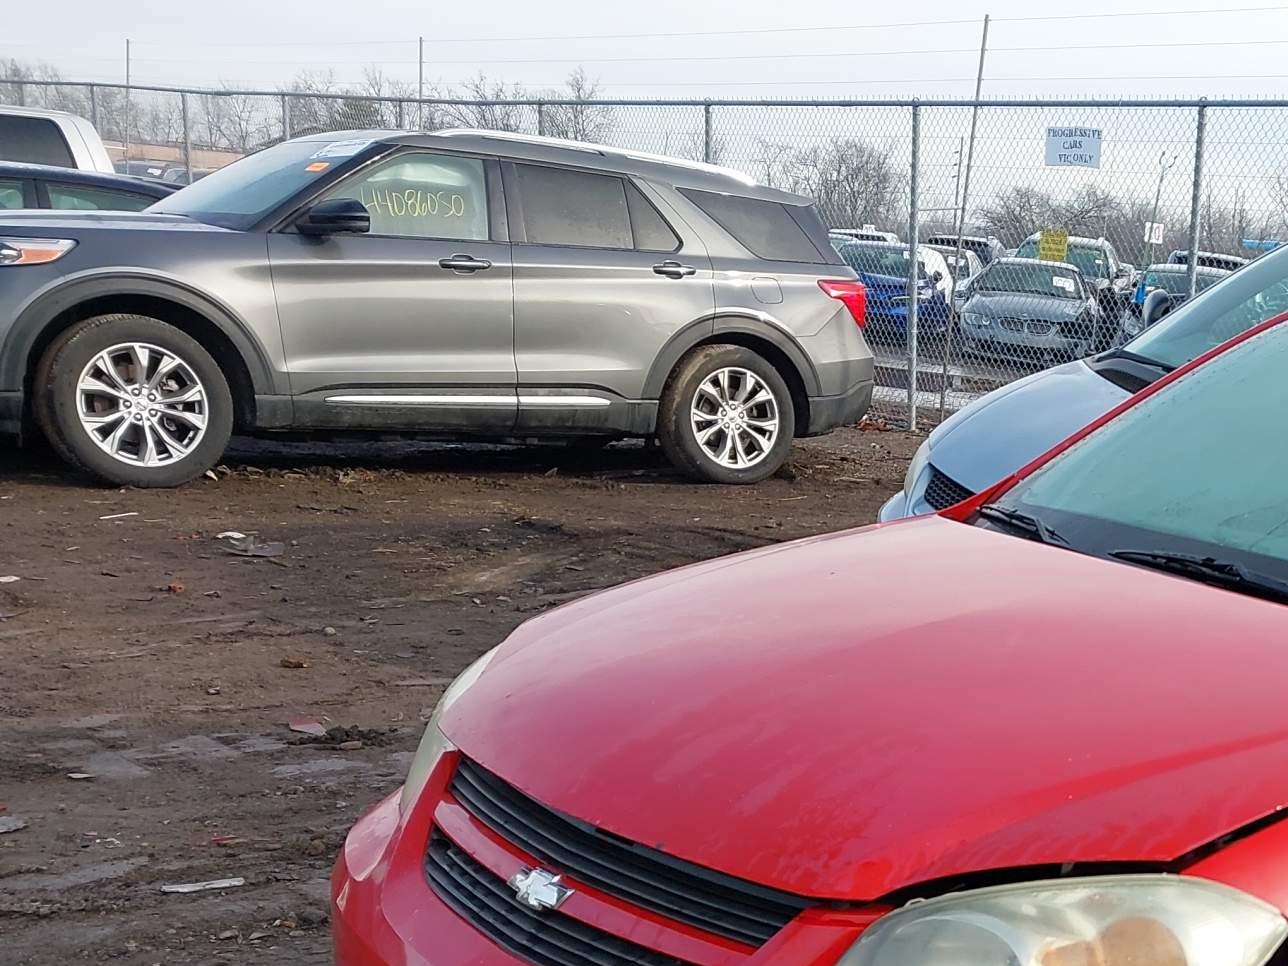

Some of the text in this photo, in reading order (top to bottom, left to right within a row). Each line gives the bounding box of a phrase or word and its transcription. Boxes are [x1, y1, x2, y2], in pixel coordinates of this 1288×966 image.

[1047, 128, 1102, 140] PROGRESSIVE
[1062, 140, 1083, 150] CARS
[1073, 153, 1094, 164] ONLY
[360, 186, 465, 217] 44086050
